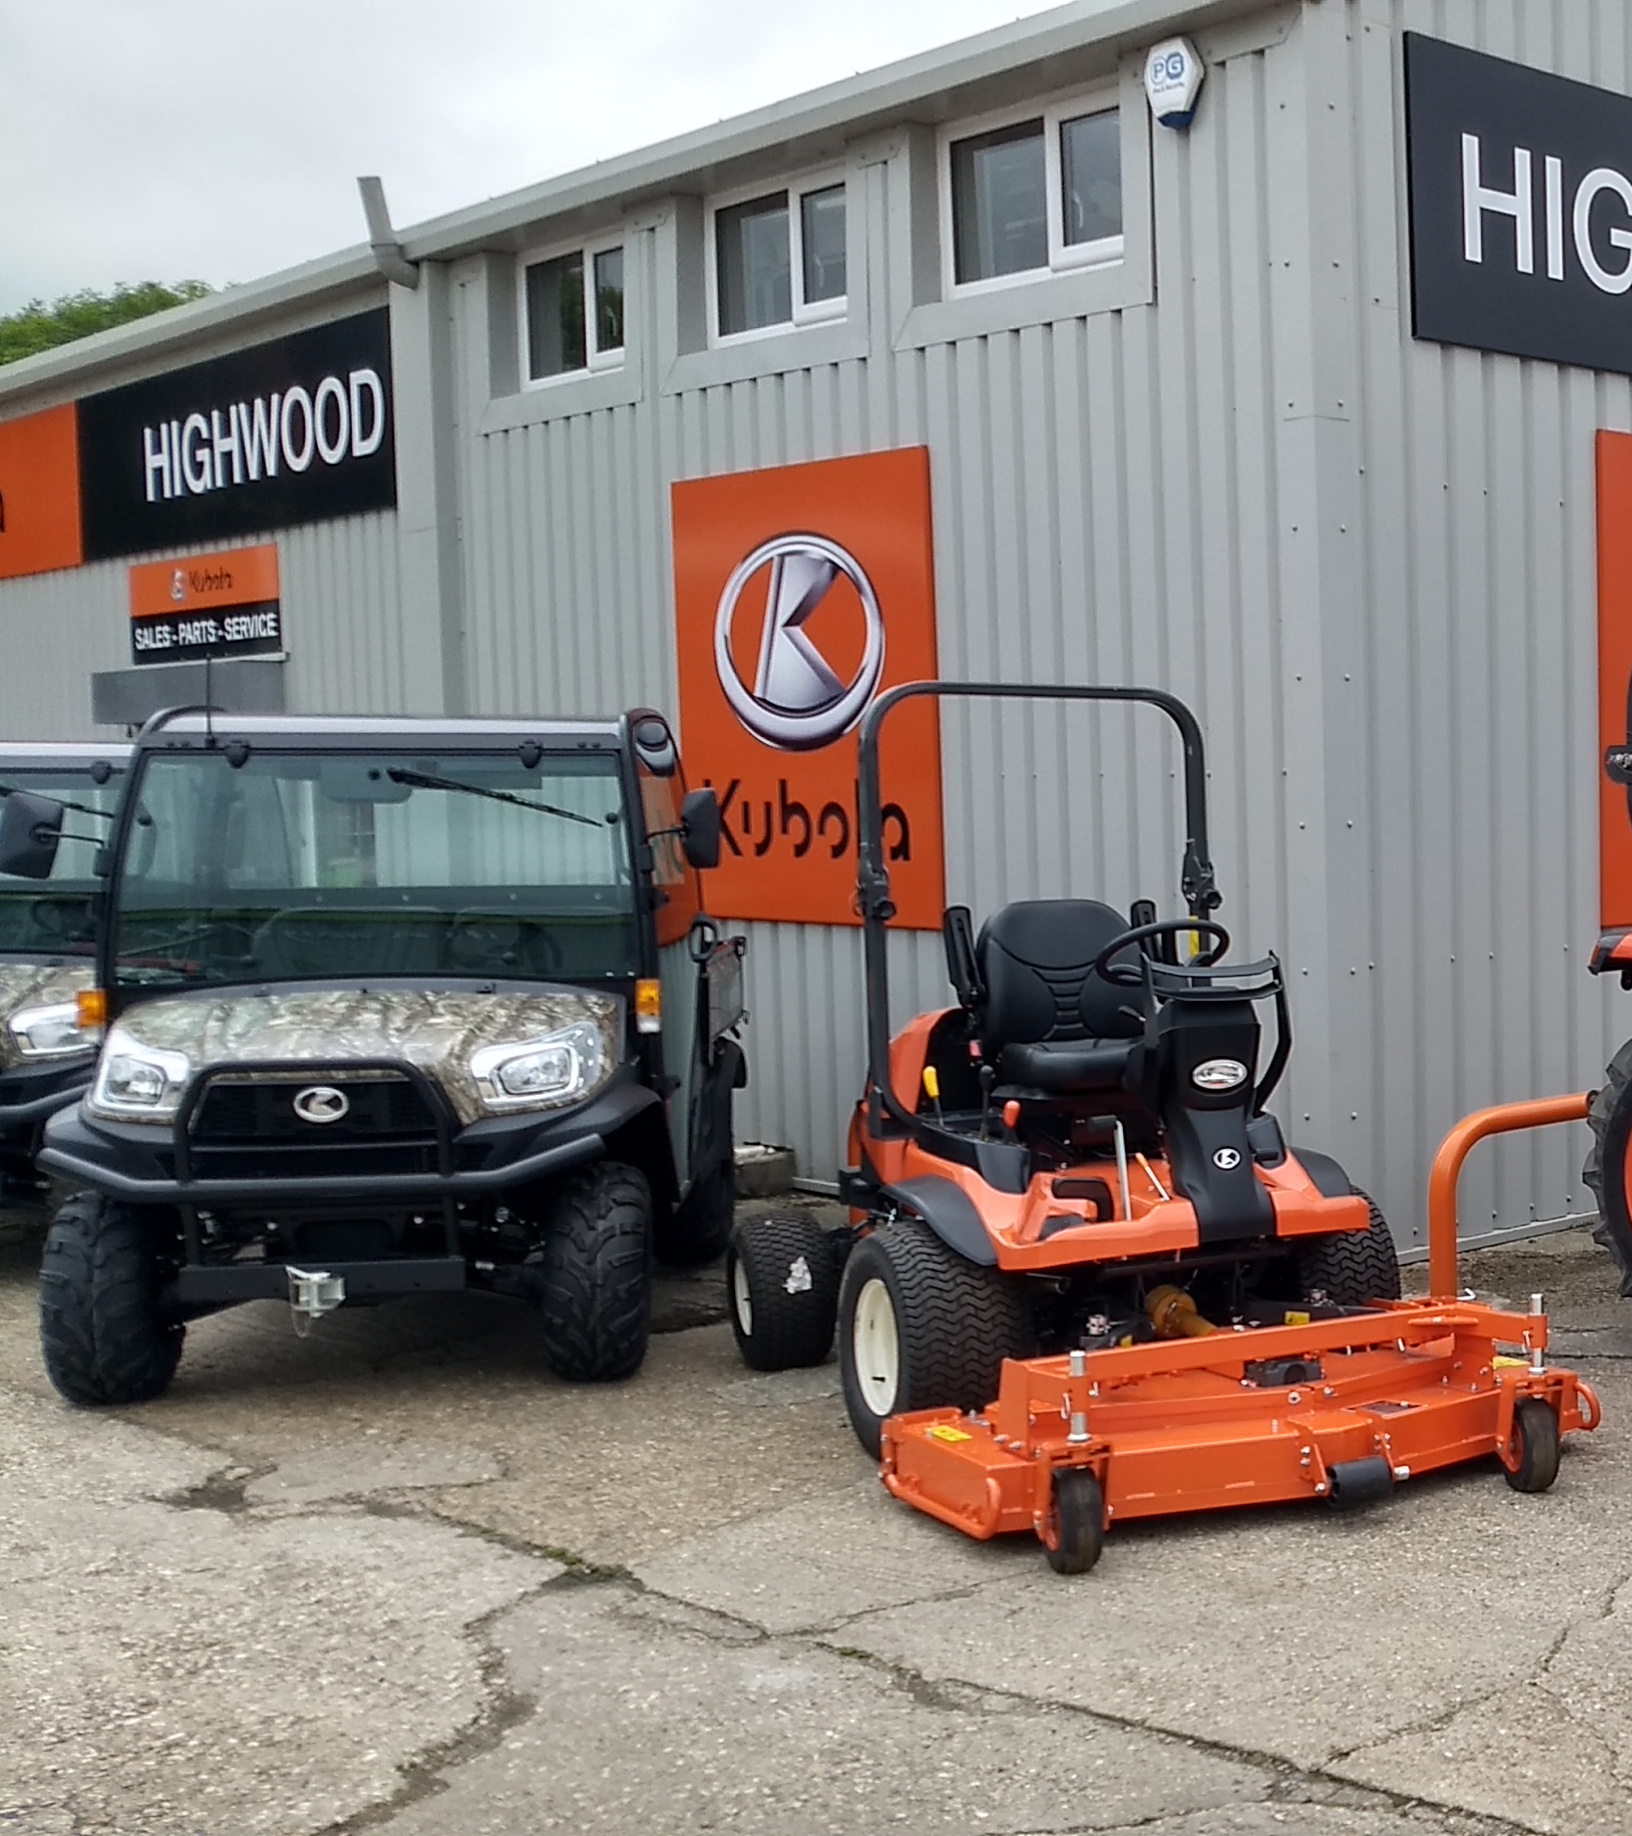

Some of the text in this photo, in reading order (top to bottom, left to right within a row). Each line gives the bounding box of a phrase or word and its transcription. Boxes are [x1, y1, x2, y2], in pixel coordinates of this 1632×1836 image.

[143, 368, 384, 502] HIGHWOOD
[188, 565, 233, 594] Kubota
[134, 612, 279, 650] SALES PARTS SERVICE
